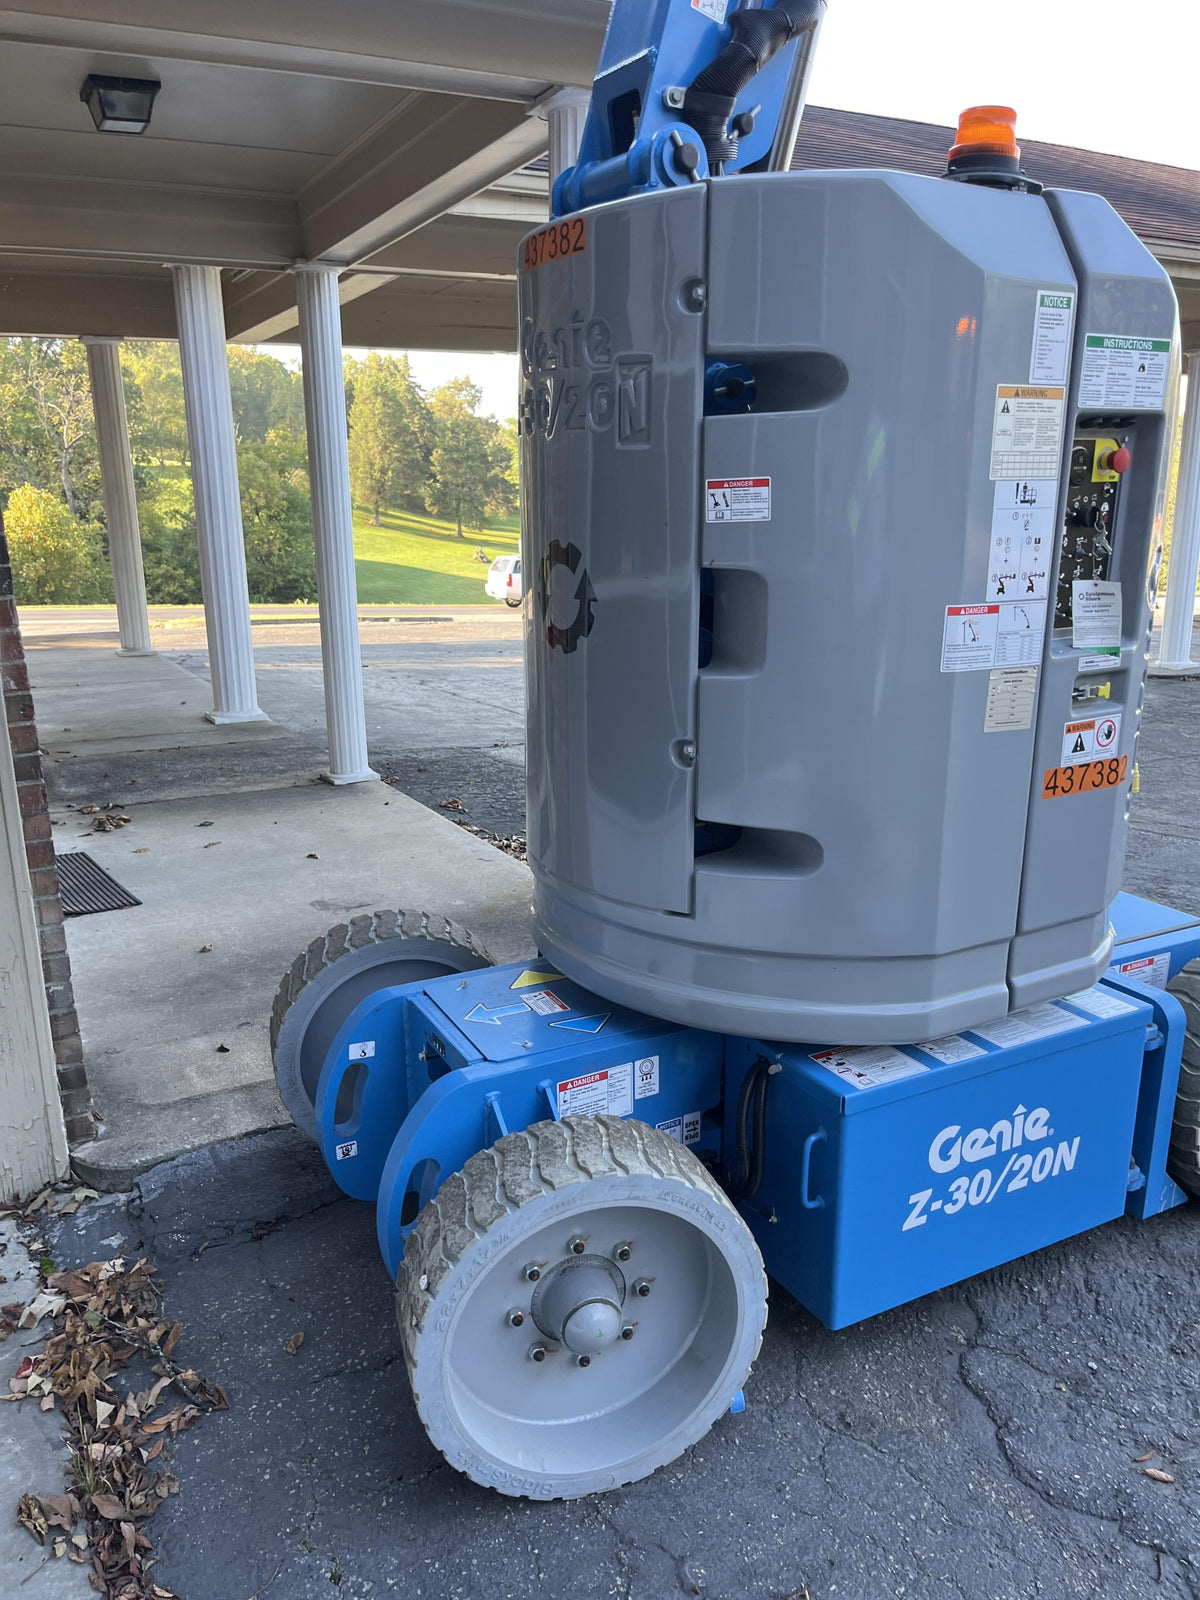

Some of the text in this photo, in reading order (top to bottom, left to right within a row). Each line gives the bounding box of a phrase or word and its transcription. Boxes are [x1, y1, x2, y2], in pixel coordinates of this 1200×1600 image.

[524, 218, 585, 267] 437382
[1044, 296, 1068, 308] NOTICE
[1103, 338, 1153, 350] INSTRUCTIONS
[1021, 389, 1048, 398] WARNING
[729, 480, 754, 488] DANGER
[965, 606, 989, 615] DANGER
[1071, 721, 1095, 732] WARNING
[1045, 755, 1128, 796] 437382
[1131, 960, 1149, 969] DANGER
[573, 1074, 600, 1088] DANGER
[685, 1120, 700, 1129] OPEN
[902, 1135, 1081, 1232] Z-30/20N
